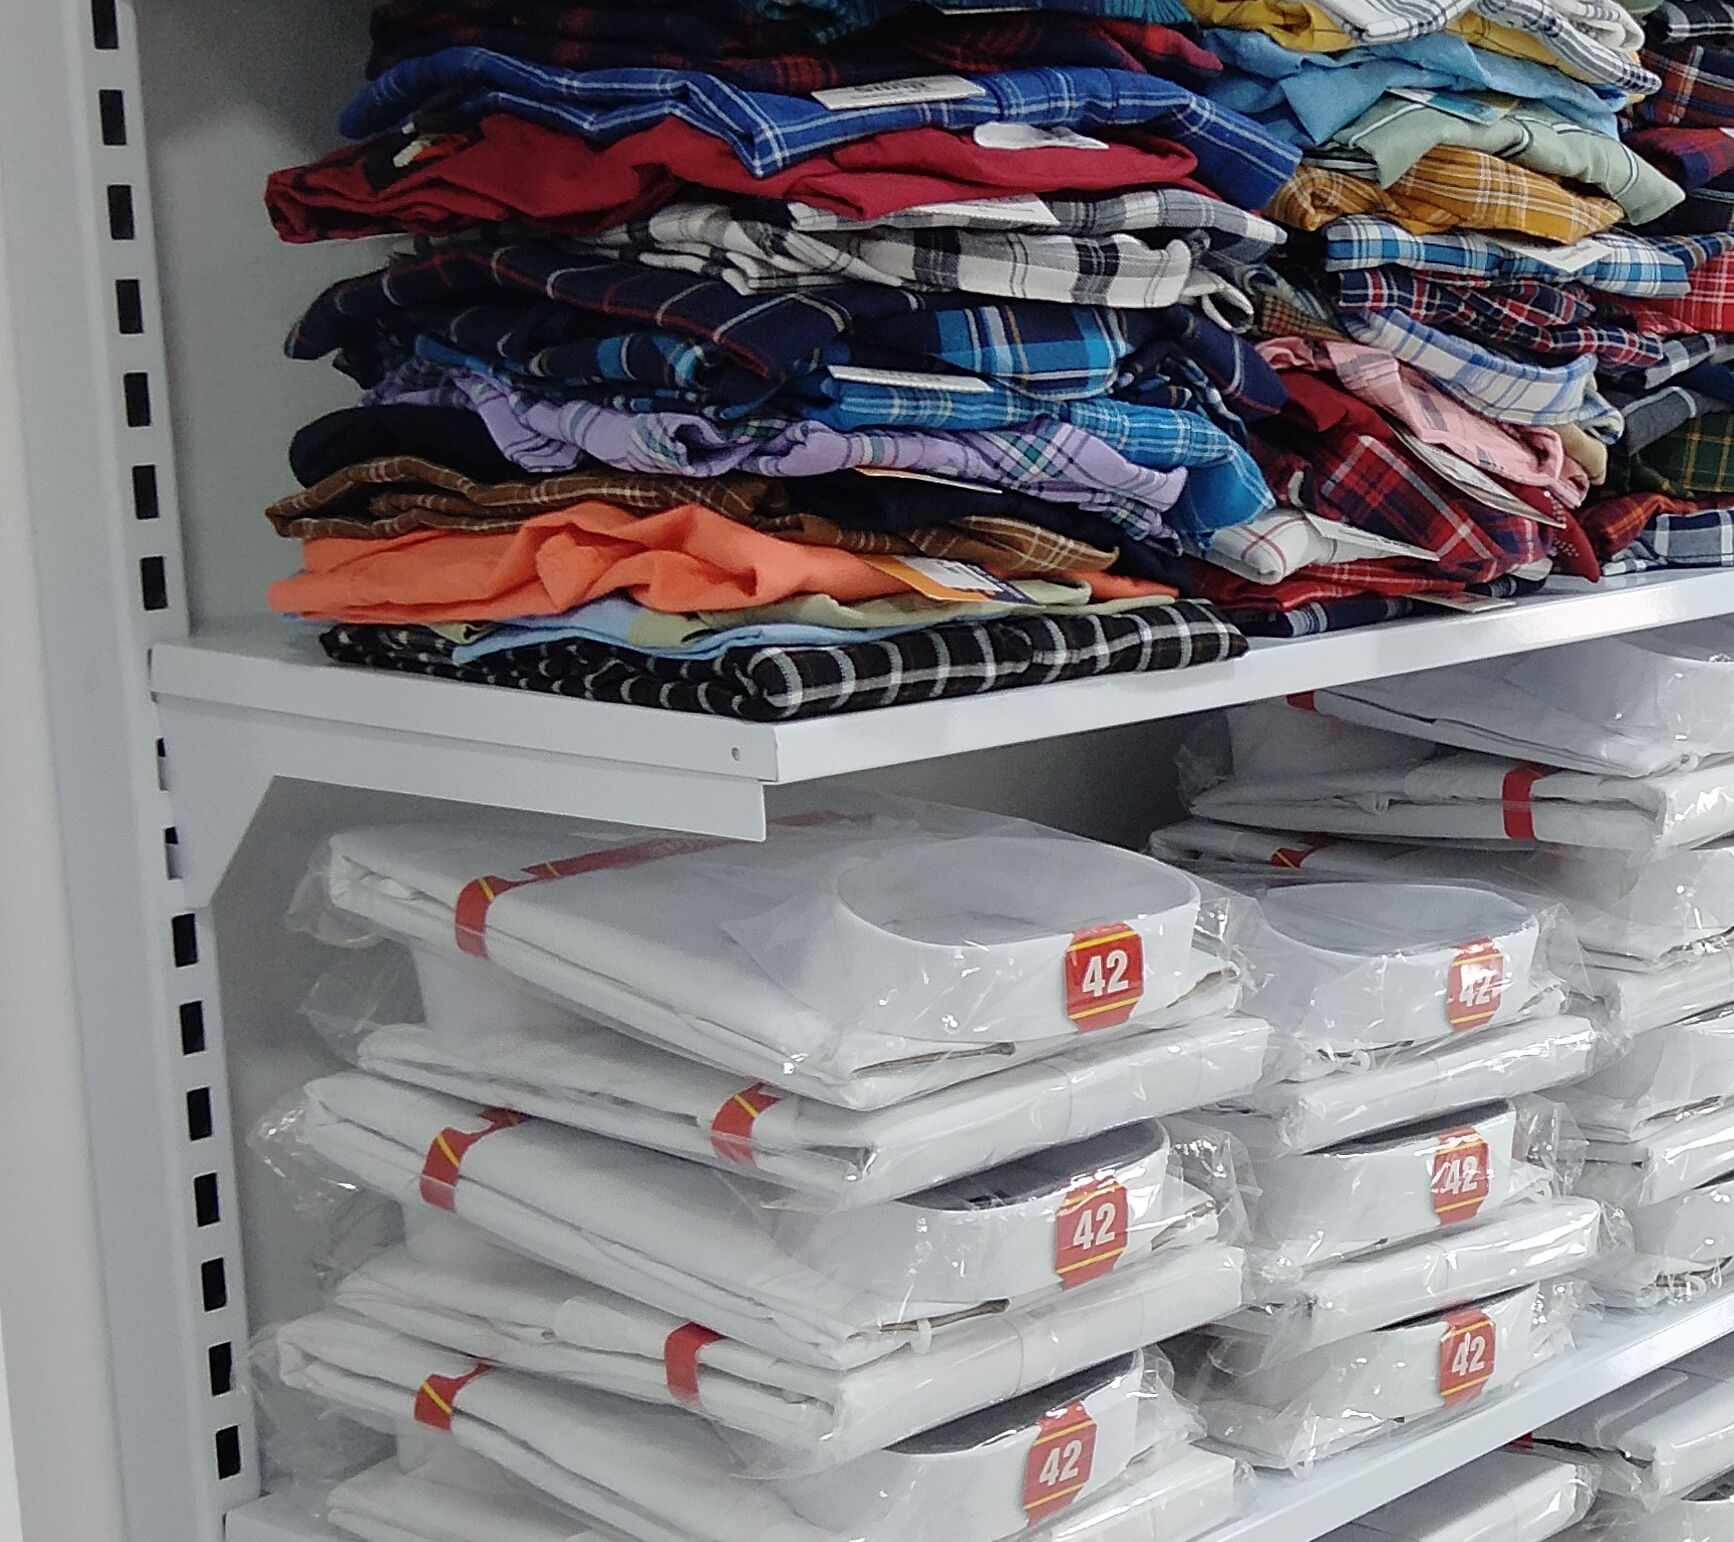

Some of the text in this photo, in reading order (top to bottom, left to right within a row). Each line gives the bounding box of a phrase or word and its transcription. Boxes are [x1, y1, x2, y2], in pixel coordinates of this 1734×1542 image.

[1082, 950, 1129, 997] 42
[1459, 964, 1491, 1006] 42
[1444, 1156, 1477, 1194] 42
[1073, 1202, 1116, 1250] 42
[1452, 1335, 1486, 1377] 42
[1039, 1439, 1083, 1486] 42
